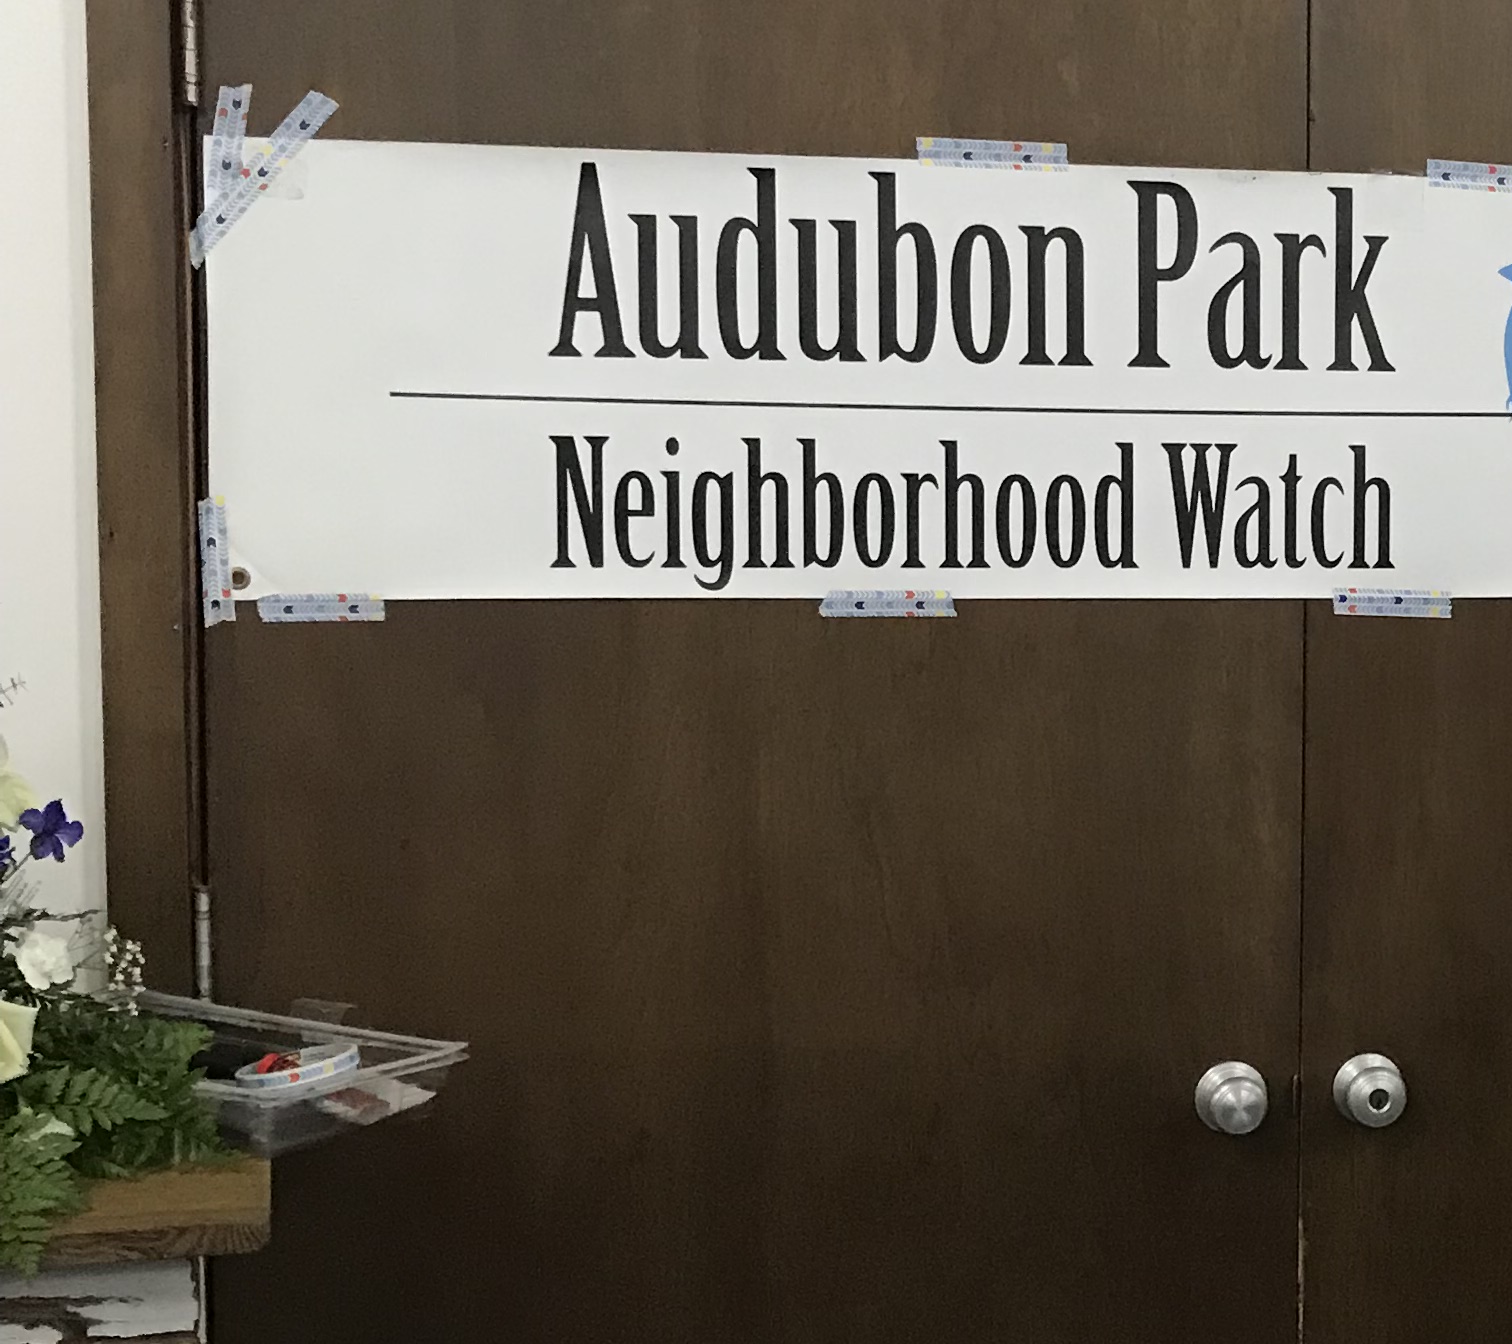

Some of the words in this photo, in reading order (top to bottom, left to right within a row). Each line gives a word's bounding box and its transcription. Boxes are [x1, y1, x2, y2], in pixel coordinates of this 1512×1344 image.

[547, 161, 1095, 367] Audubon
[1126, 180, 1396, 373] Park
[547, 435, 1141, 592] Neighborhood
[1162, 442, 1396, 570] Watch
